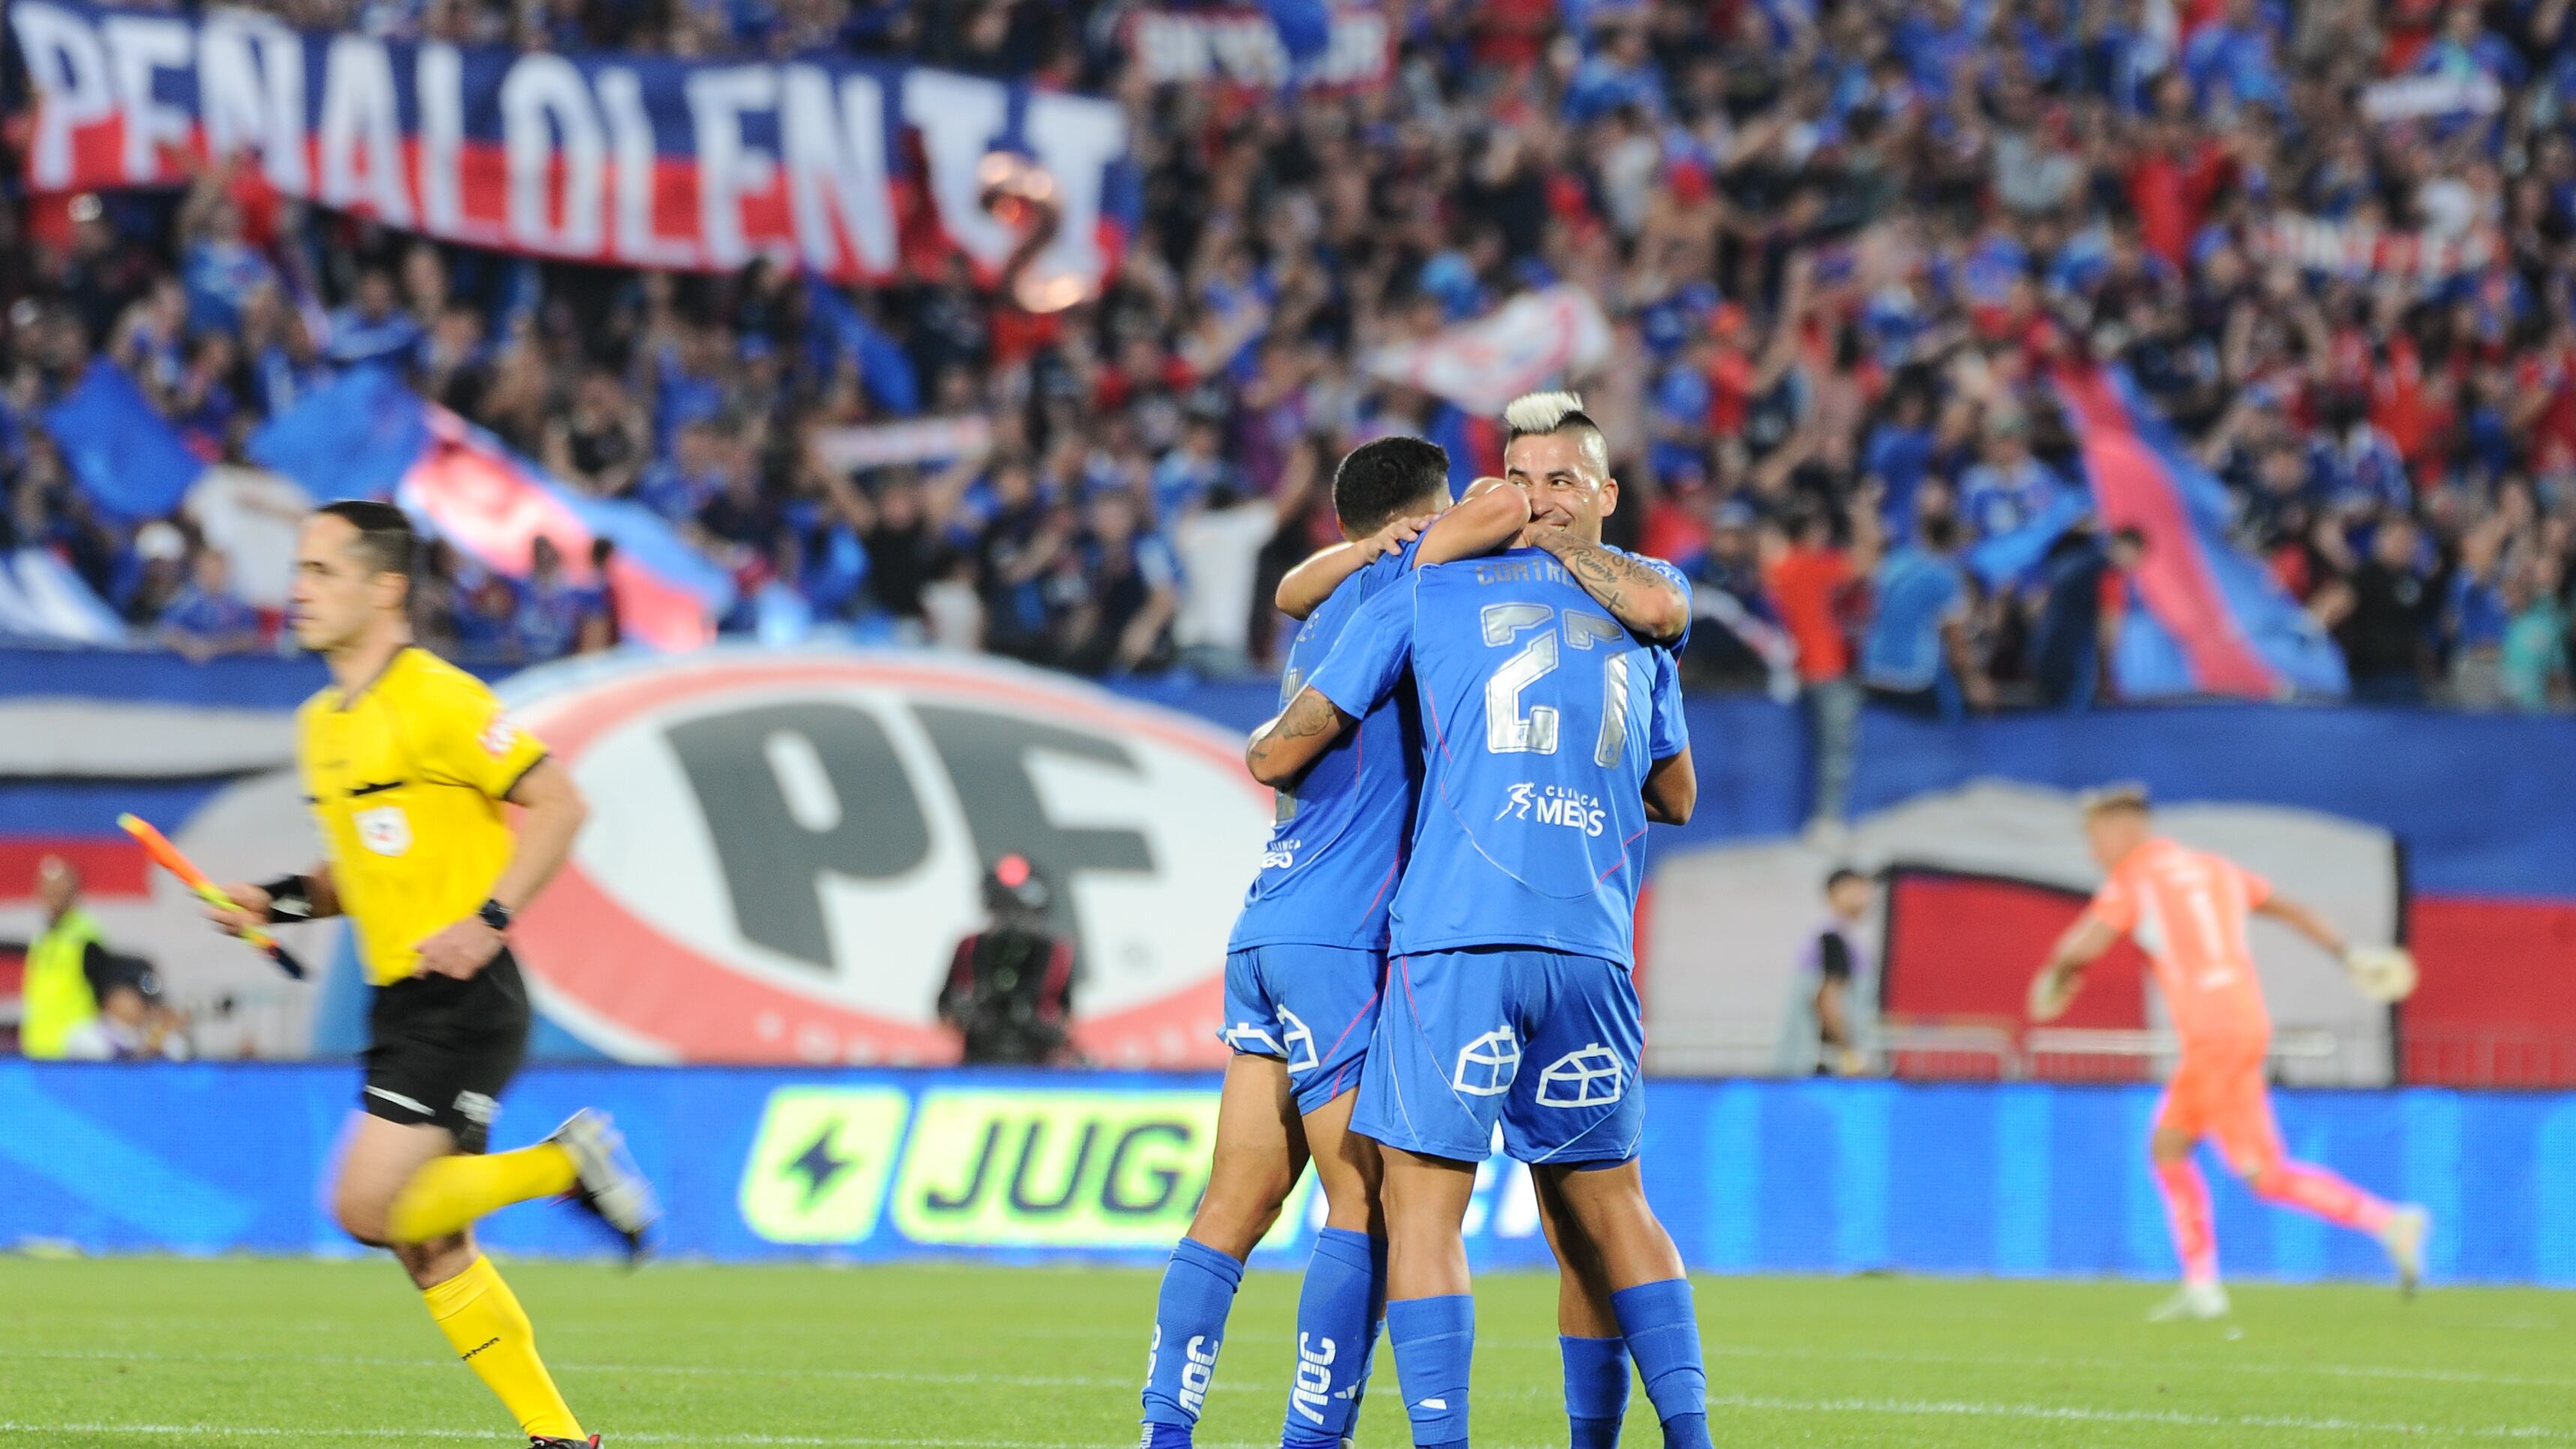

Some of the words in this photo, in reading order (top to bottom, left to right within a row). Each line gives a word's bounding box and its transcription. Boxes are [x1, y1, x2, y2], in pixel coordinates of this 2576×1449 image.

[1480, 602, 1629, 769] 27
[664, 702, 1159, 982] PF
[926, 1120, 1210, 1215] JUG
